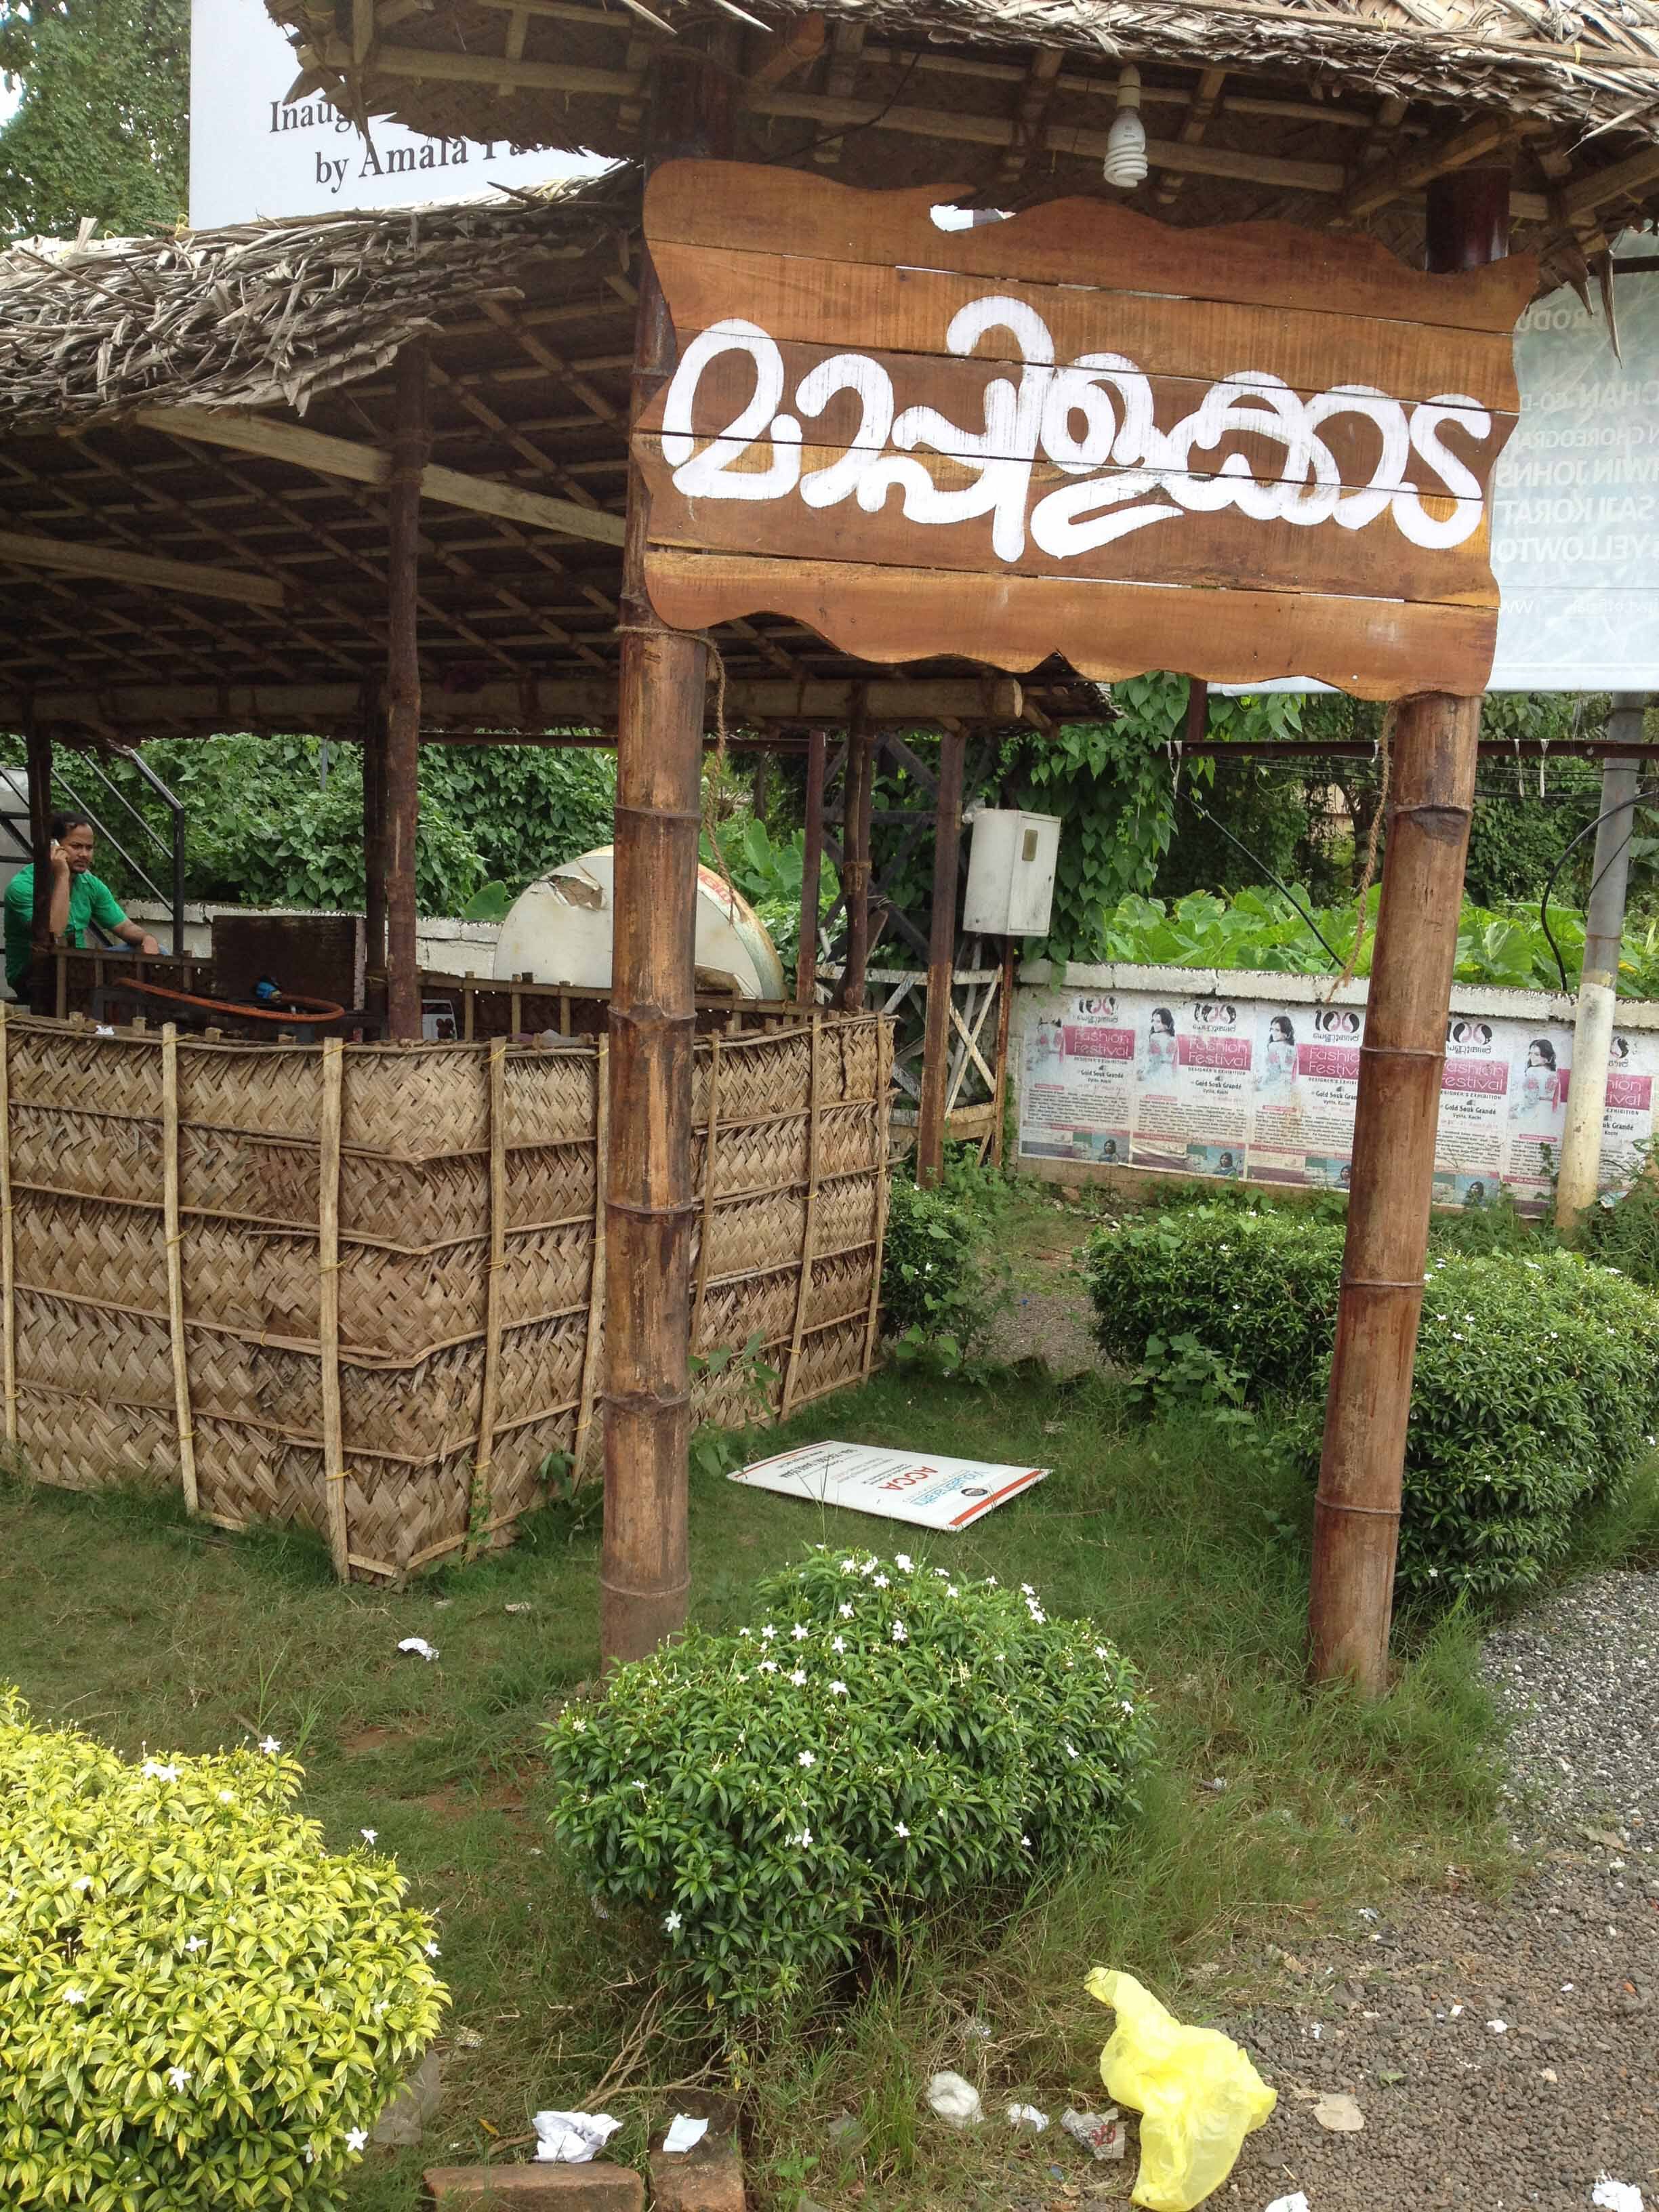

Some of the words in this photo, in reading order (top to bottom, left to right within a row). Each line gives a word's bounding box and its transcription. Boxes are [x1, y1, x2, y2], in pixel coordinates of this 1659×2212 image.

[270, 101, 352, 133] Inaug
[315, 151, 350, 193] by
[358, 137, 469, 178] Amala
[1075, 1029, 1130, 1045] Fashion
[1189, 1036, 1248, 1053] Fashion
[1073, 1041, 1129, 1058] Festival
[1309, 1046, 1361, 1063] Fashio
[1188, 1050, 1247, 1067] Festival
[1308, 1061, 1359, 1077] Festiv
[1444, 1060, 1504, 1078] ashion
[878, 1466, 938, 1490] ACCA
